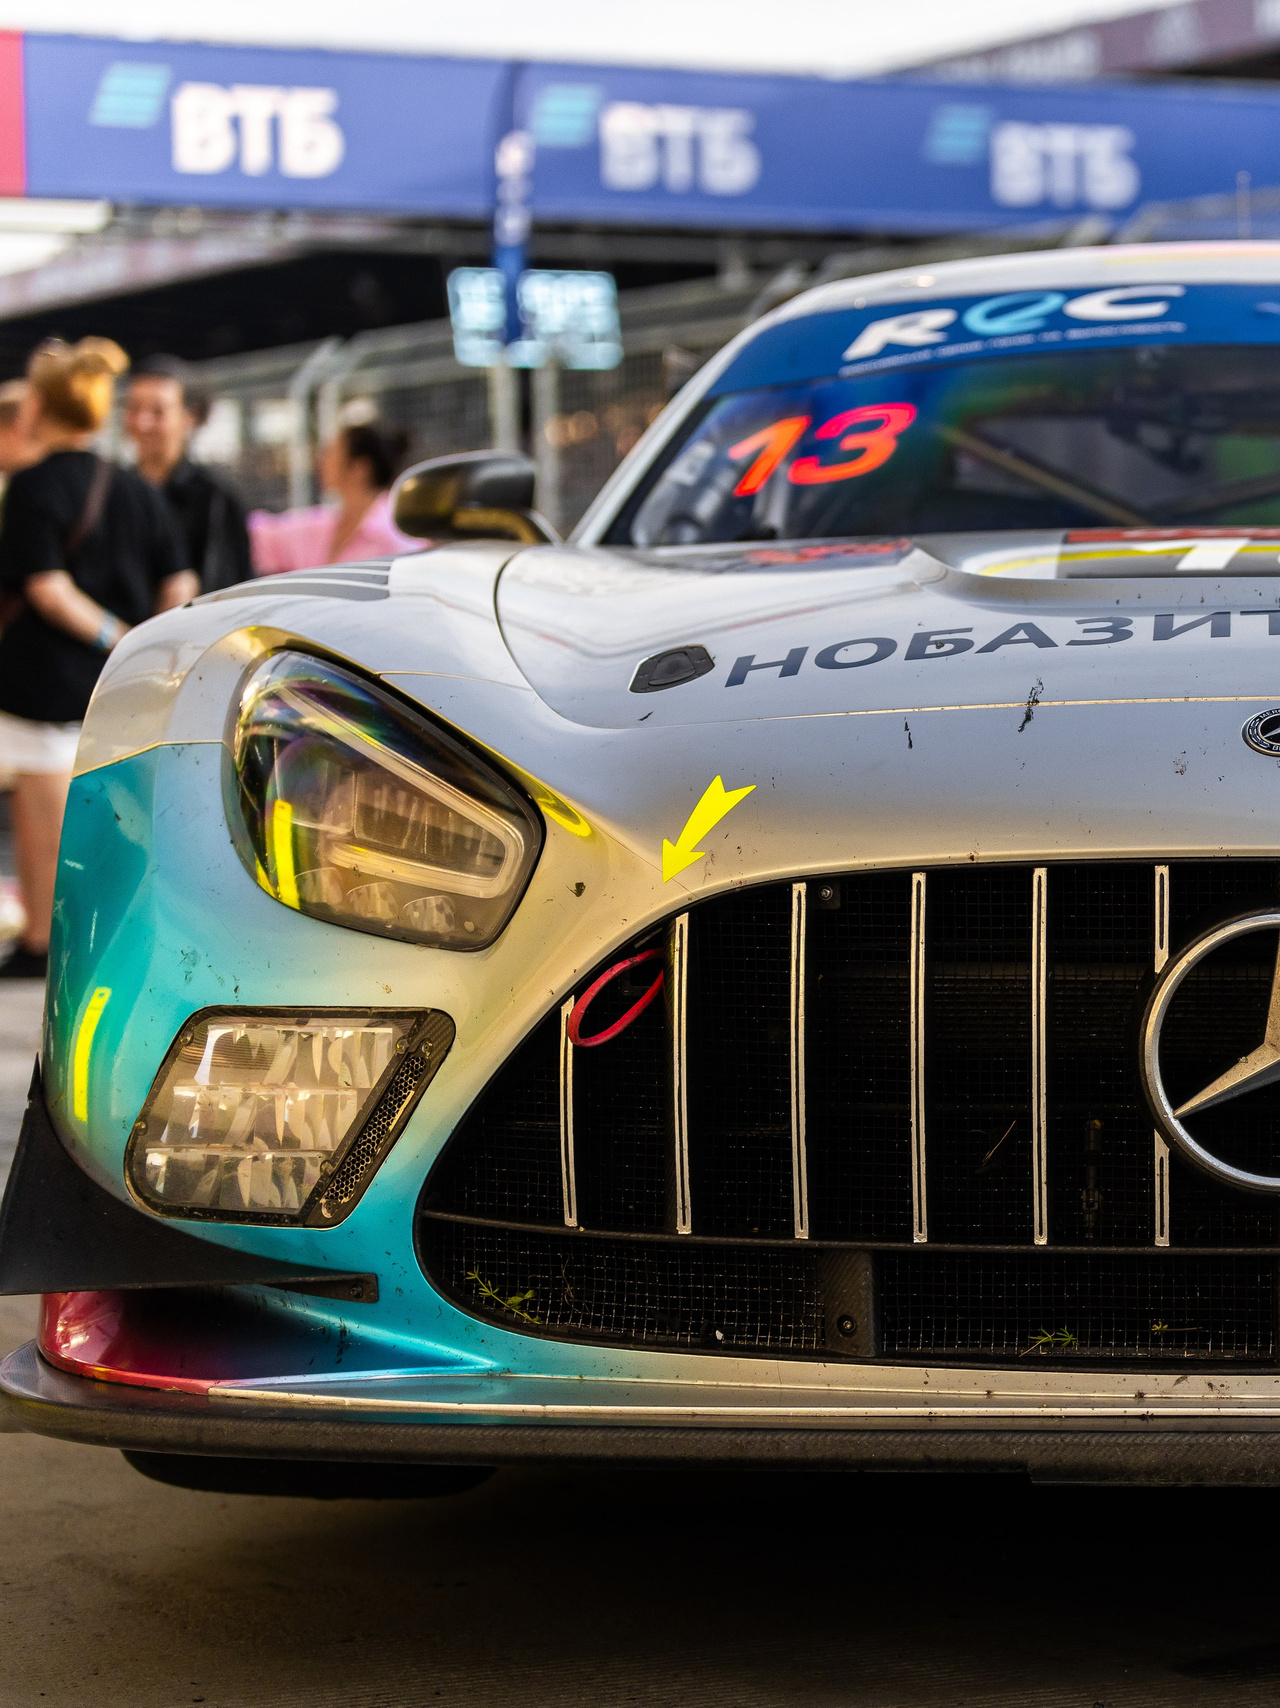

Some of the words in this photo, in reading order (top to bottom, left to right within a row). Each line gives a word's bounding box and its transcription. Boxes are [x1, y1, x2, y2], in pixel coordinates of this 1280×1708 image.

[172, 82, 346, 178] ВТБ
[602, 102, 761, 194] ВТБ
[991, 120, 1139, 208] ВТБ
[728, 402, 917, 497] 13
